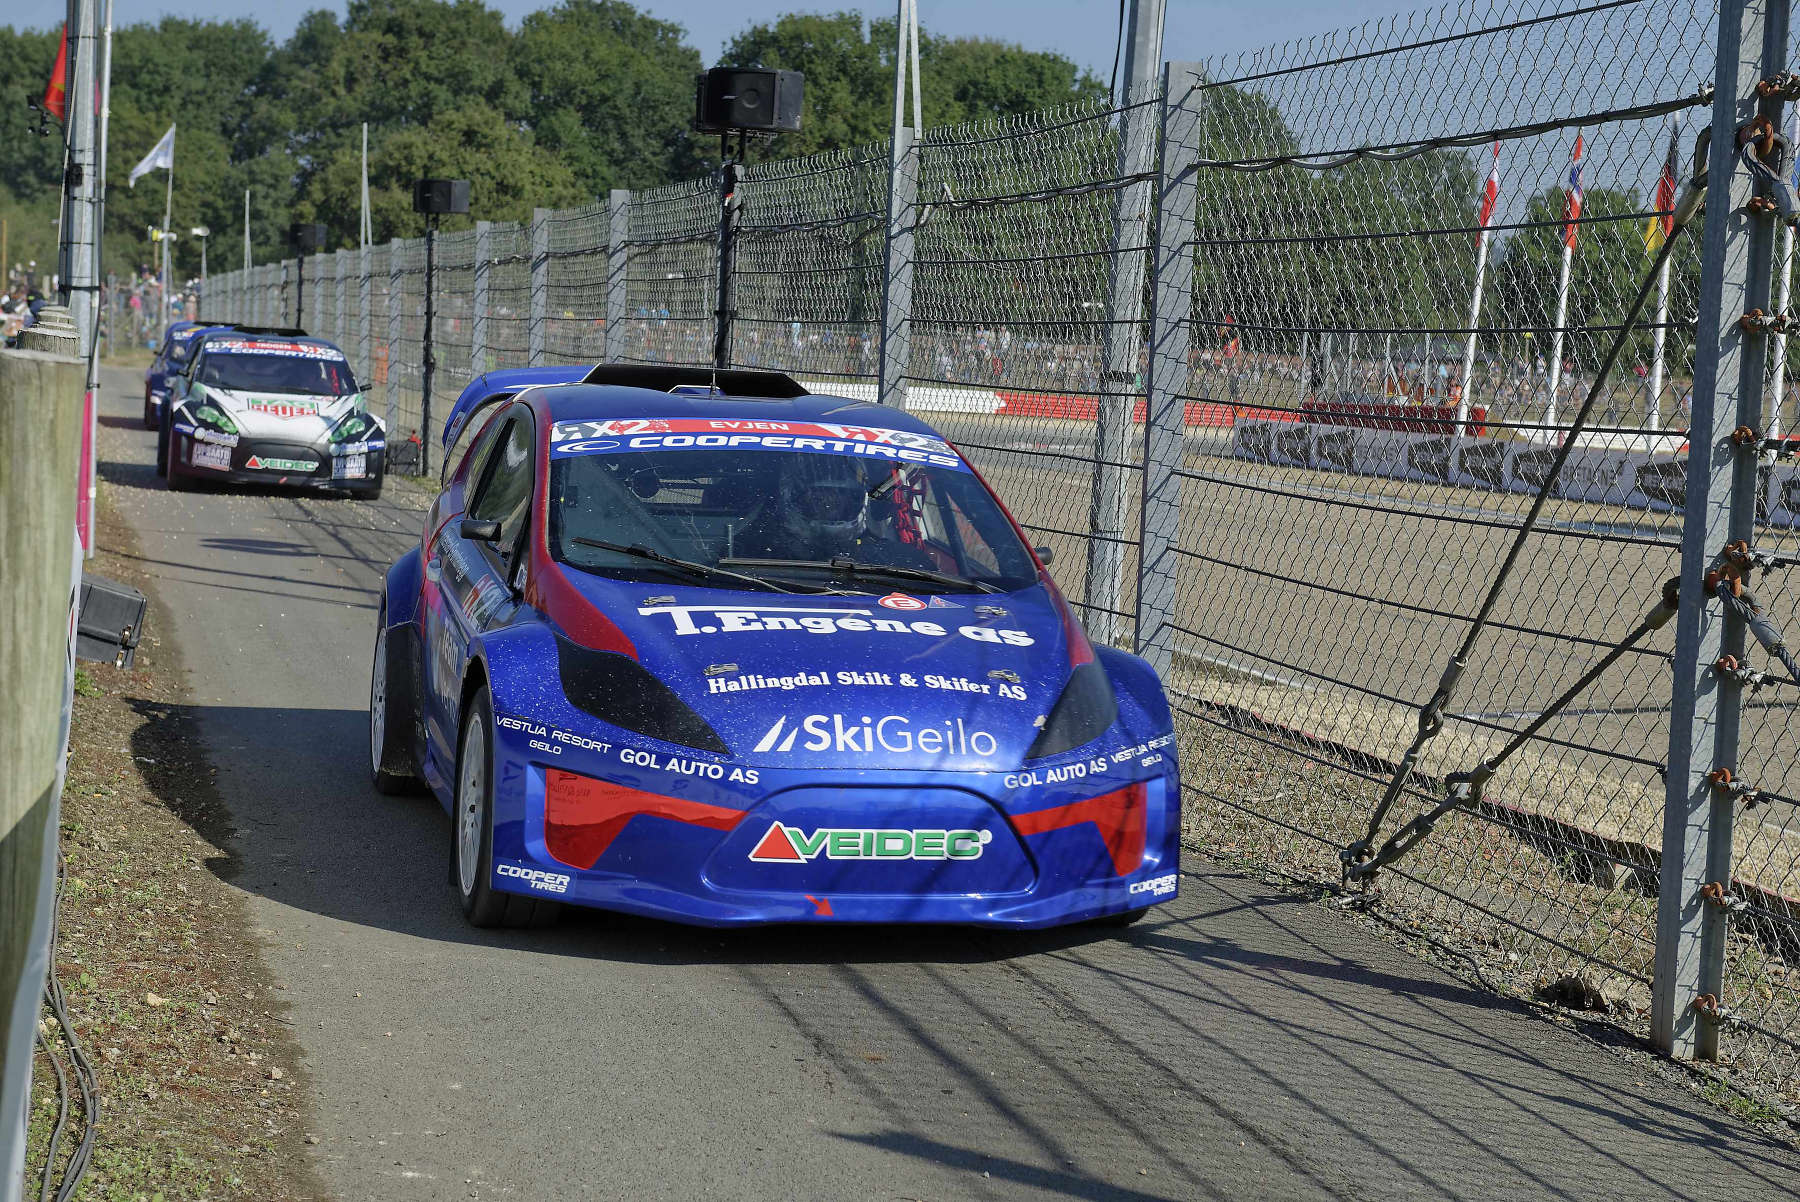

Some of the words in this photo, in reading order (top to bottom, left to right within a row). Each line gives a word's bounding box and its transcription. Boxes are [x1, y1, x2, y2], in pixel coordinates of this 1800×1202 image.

[709, 421, 790, 431] EVJEN
[629, 435, 959, 468] COOPERTIRES
[258, 458, 316, 471] VEIDEC
[958, 625, 1035, 647] as
[708, 672, 830, 694] Hallingdal
[838, 671, 893, 687] Skilt
[900, 673, 919, 687] &
[925, 674, 990, 696] Skifer
[998, 684, 1028, 701] AS
[552, 730, 612, 754] RESORT
[803, 714, 998, 756] SkiGeilo
[529, 739, 562, 755] GEILO
[620, 748, 661, 770] GOL
[666, 757, 724, 780] AUTO
[728, 767, 759, 785] AS
[1004, 773, 1043, 789] GOL
[1046, 763, 1087, 784] AUTO
[1089, 757, 1107, 775] AS
[786, 828, 984, 860] VEIDEC
[496, 865, 571, 886] COOPER
[530, 880, 567, 893] TIRES
[1129, 874, 1178, 894] COOPER
[1153, 886, 1176, 897] TIRES
